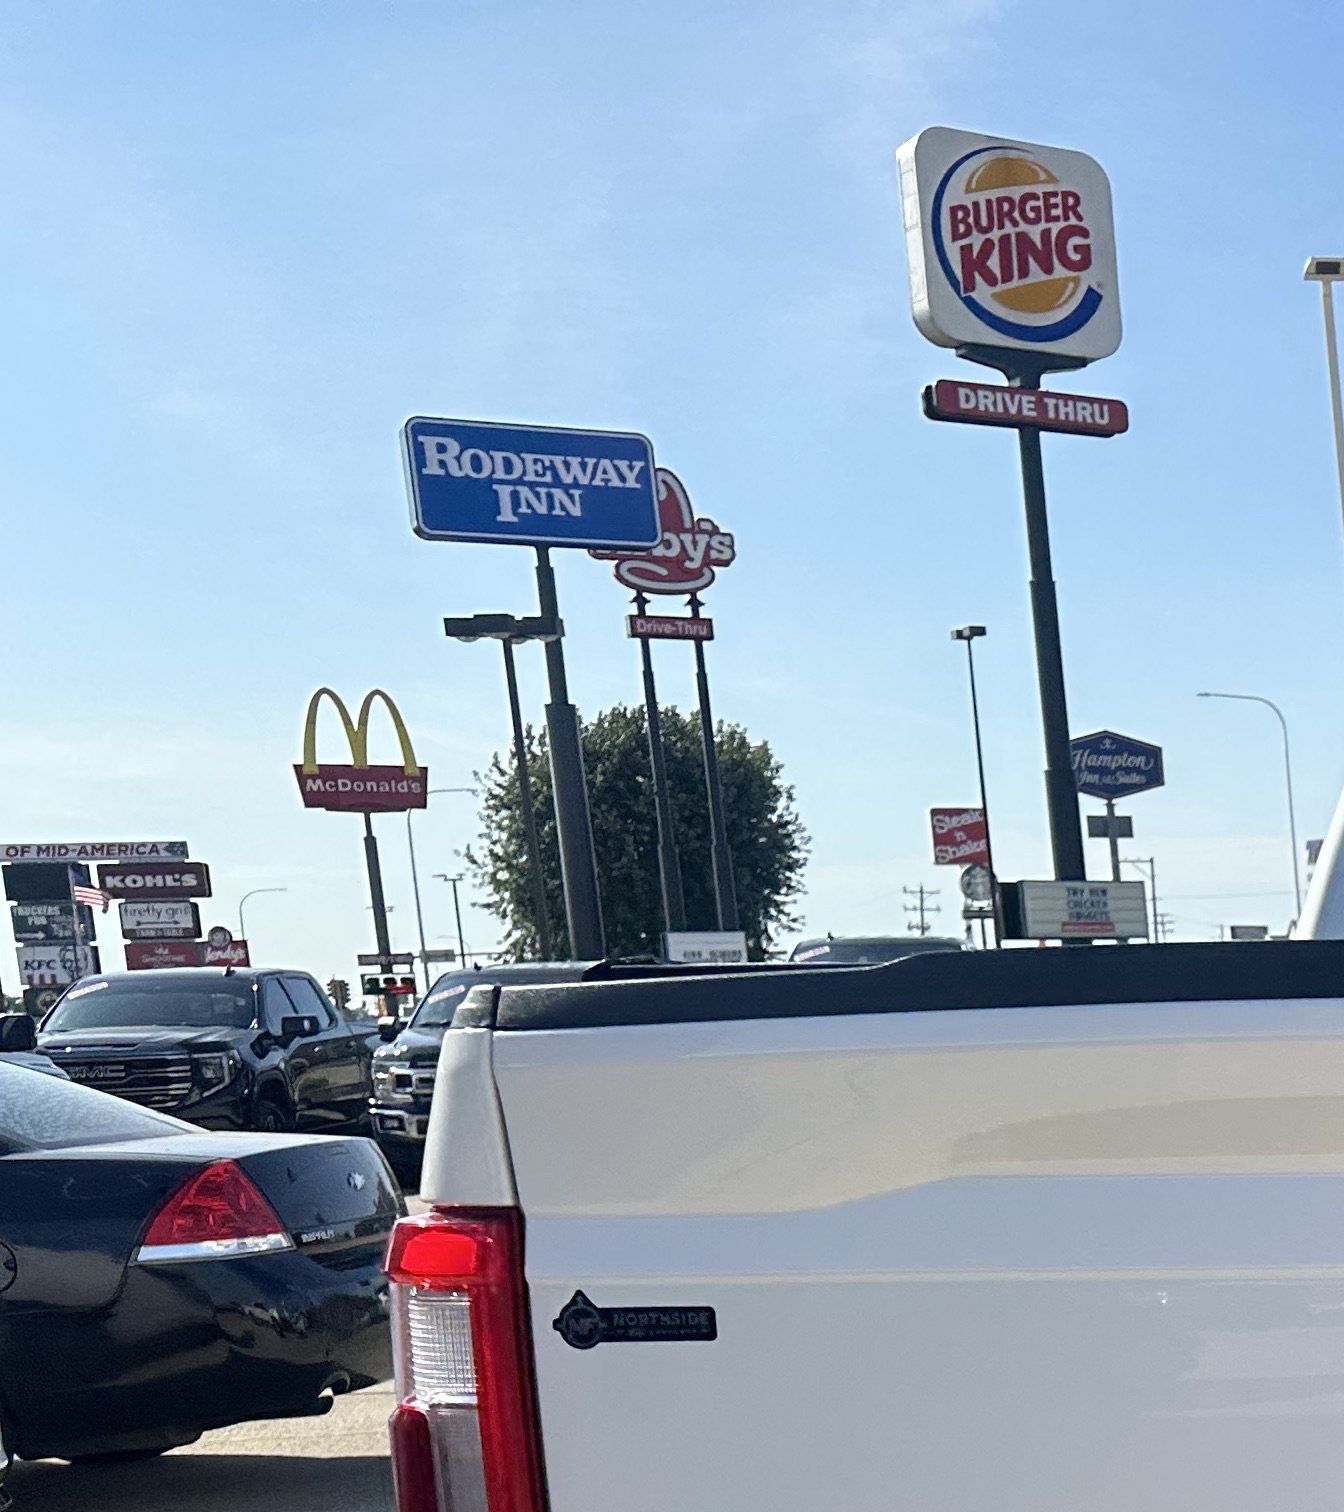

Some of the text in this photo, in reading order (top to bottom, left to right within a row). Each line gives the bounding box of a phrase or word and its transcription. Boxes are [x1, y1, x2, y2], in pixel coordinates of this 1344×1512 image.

[949, 190, 1084, 242] BURGER
[959, 224, 1092, 294] KING
[958, 387, 1110, 426] DRIVE THRU
[417, 435, 645, 489] RODEWAY
[492, 484, 583, 522] INN
[636, 619, 708, 636] Drive-Thru
[1071, 748, 1154, 770] Hampton
[306, 779, 422, 793] McDonald's
[5, 843, 161, 858] OF MID-AMERICA
[105, 873, 198, 888] KOHL'S
[24, 960, 57, 971] KFC
